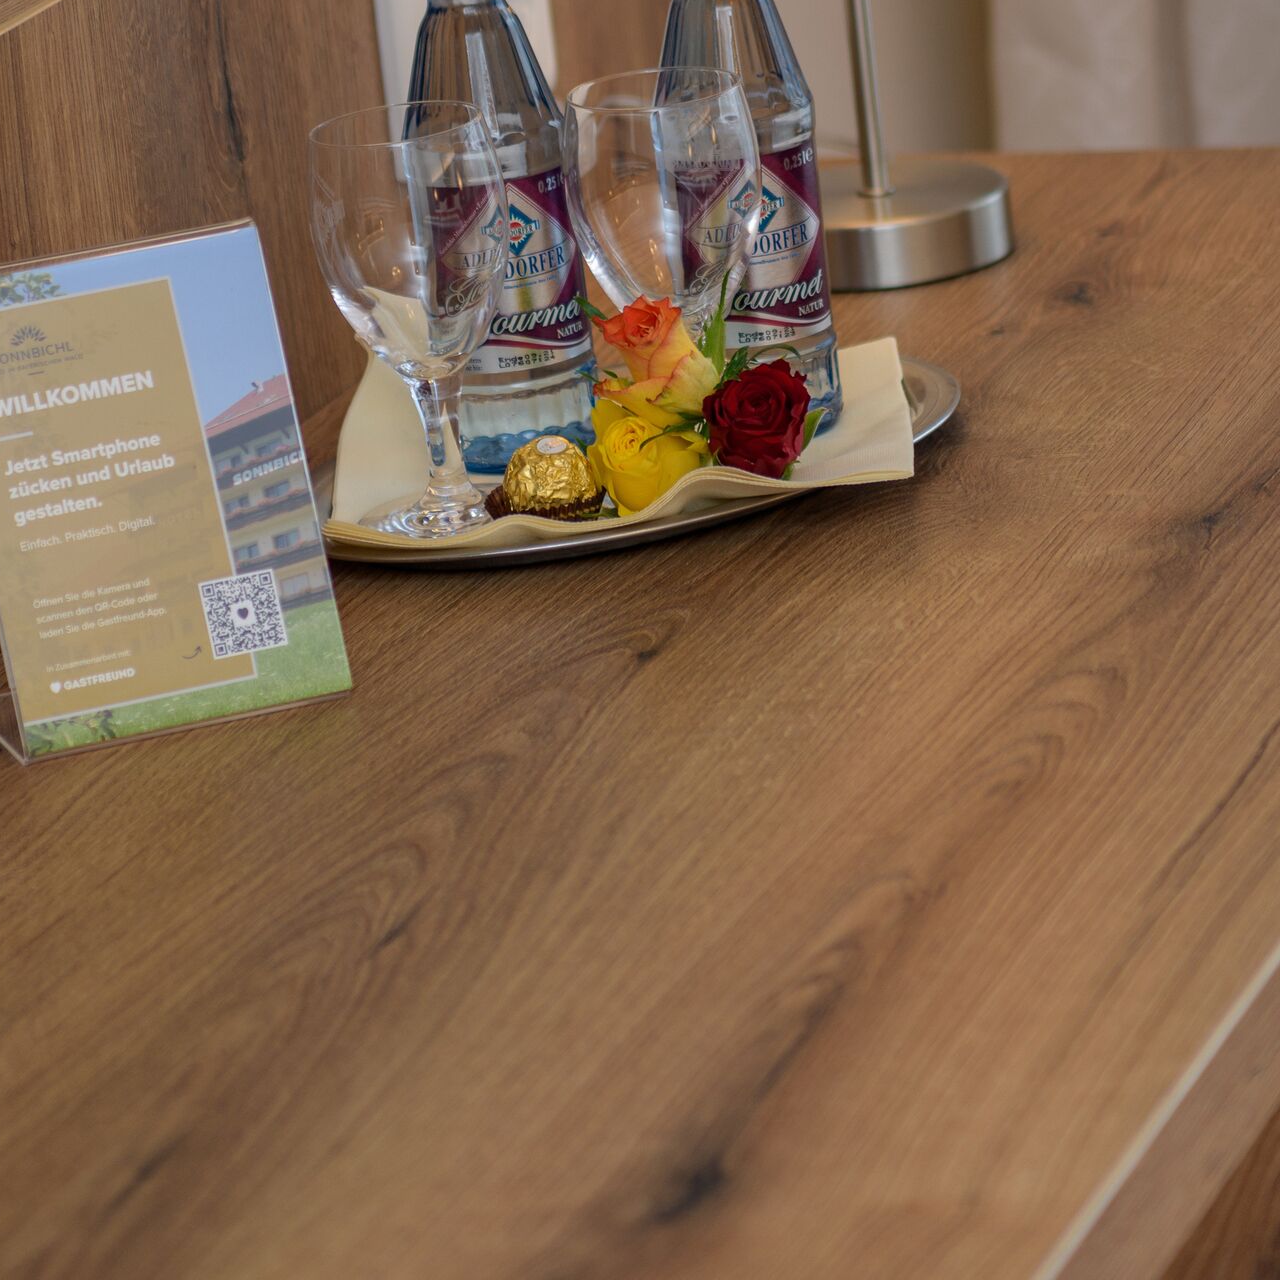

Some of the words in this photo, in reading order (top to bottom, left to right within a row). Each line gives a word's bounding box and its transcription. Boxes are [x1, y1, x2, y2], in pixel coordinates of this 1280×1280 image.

[798, 299, 824, 316] NATUR
[557, 321, 582, 338] NATUR
[4, 455, 49, 476] Jetzt
[51, 434, 161, 466] Smartphone
[8, 475, 72, 499] zücken
[76, 465, 111, 486] und
[114, 454, 175, 477] Urlaub
[13, 496, 103, 527] gestalten.
[19, 535, 63, 552] Einfach.
[65, 524, 116, 542] Praktisch.
[119, 516, 156, 532] Digital.
[64, 593, 79, 602] Sie
[81, 590, 95, 600] die
[97, 582, 131, 596] Kamera
[132, 577, 150, 589] und
[75, 605, 93, 616] den
[94, 597, 135, 612] QR-Code
[137, 592, 158, 604] oder
[39, 626, 64, 639] laden
[65, 623, 80, 634] Sie
[81, 621, 95, 631] die
[63, 667, 136, 690] GASTFREUND
